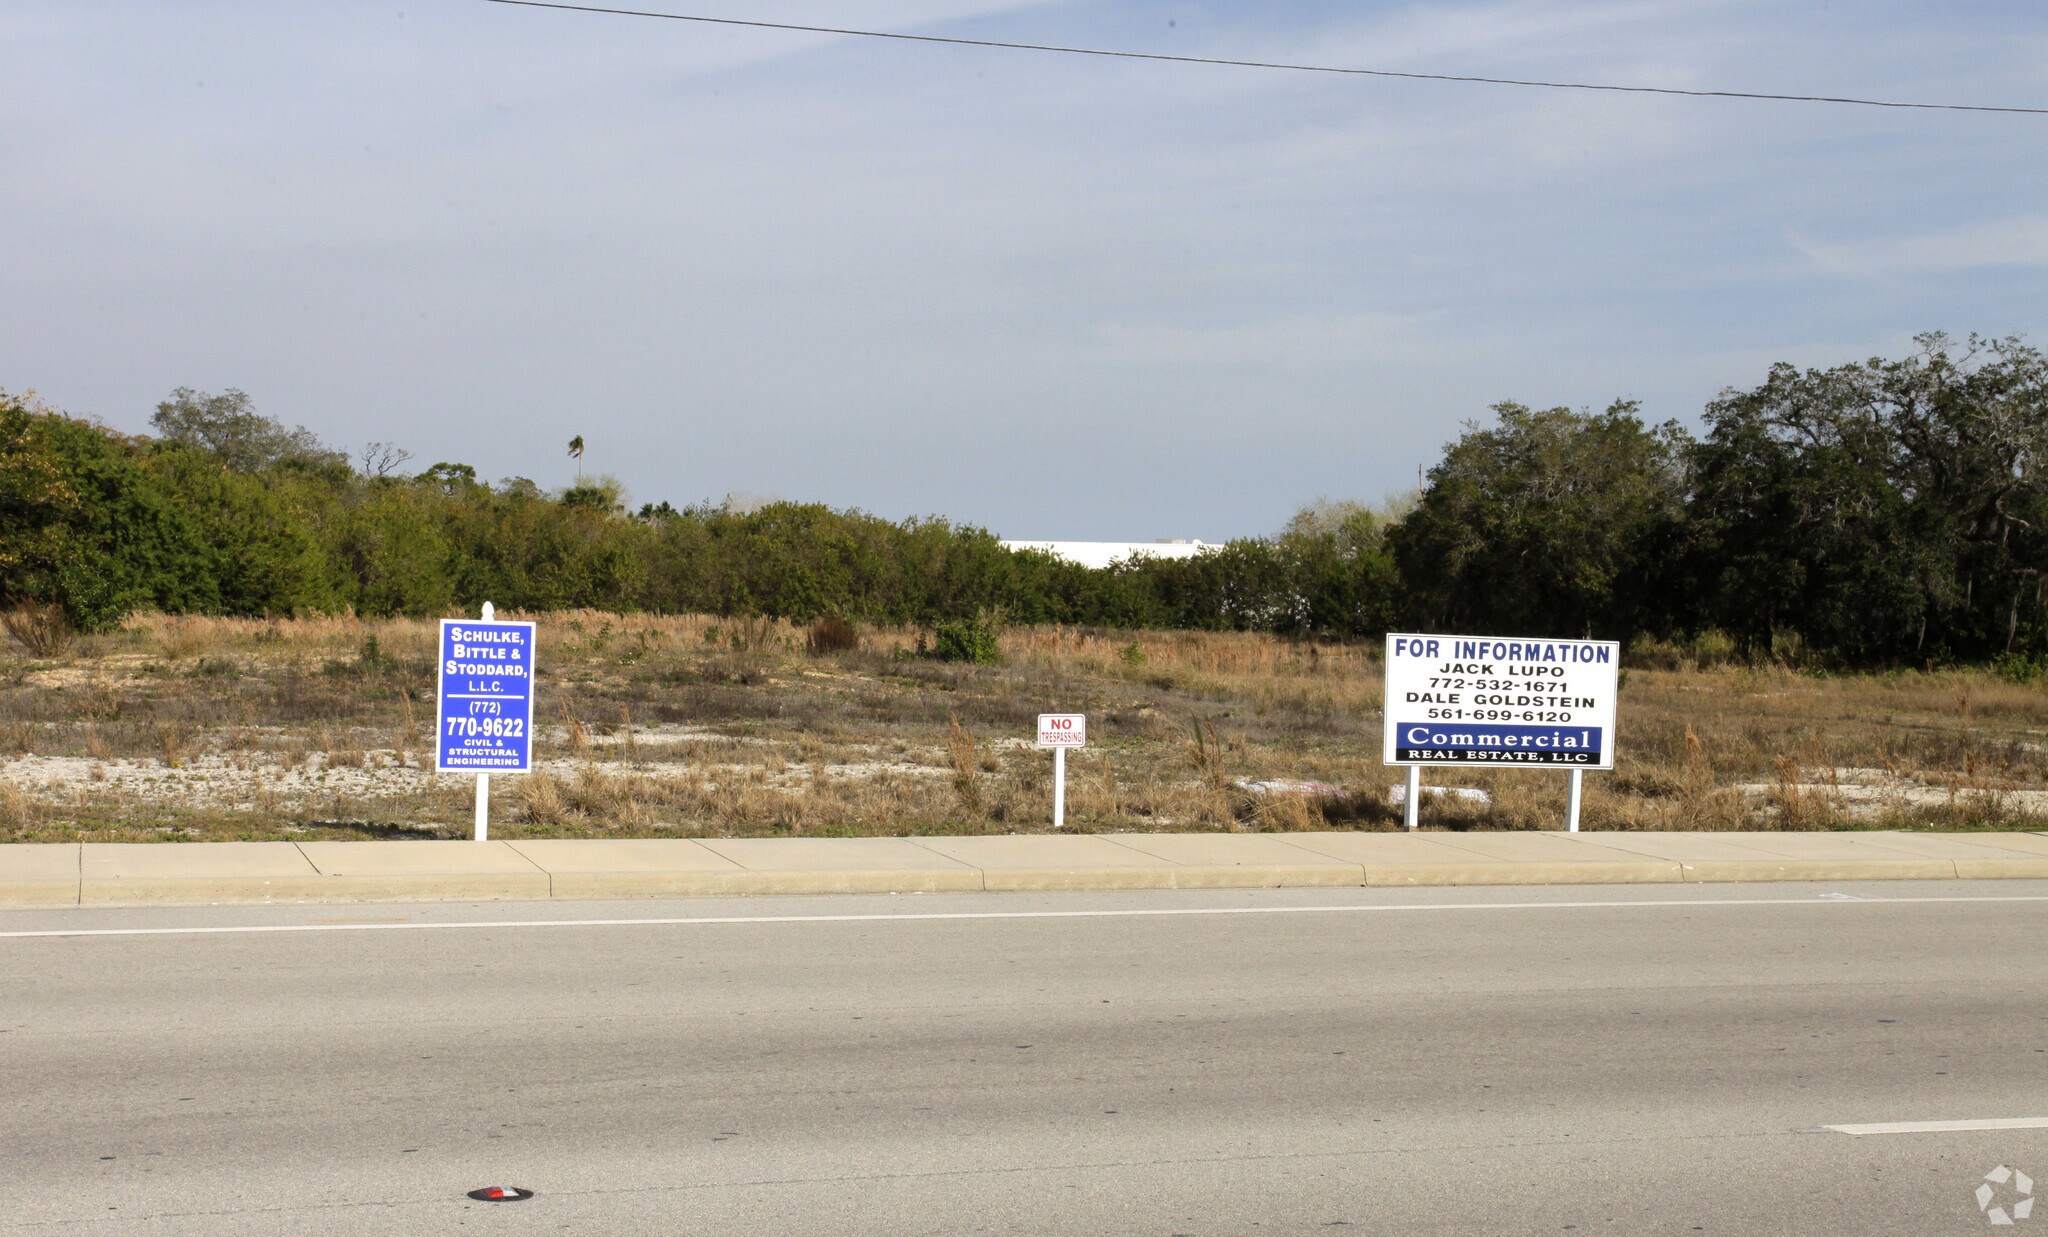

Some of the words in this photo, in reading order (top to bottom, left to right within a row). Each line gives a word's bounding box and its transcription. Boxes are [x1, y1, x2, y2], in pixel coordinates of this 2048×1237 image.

[451, 627, 524, 645] SCHULKE,
[454, 644, 506, 659] BITTLE
[511, 649, 521, 659] &
[1396, 639, 1439, 658] FOR
[1455, 641, 1609, 663] INFORMATION
[446, 661, 527, 678] STODDARD,
[1440, 663, 1494, 674] JACK
[1509, 666, 1564, 676] LUPO
[469, 681, 504, 692] L.L.C.
[1429, 678, 1567, 692] 772-532-1671
[1406, 693, 1460, 704] DALE
[1474, 695, 1595, 708] GOLDSTEIN
[469, 702, 501, 715] (772)
[1428, 709, 1571, 722] 561-699-6120
[447, 717, 523, 737] 770-9622
[1051, 719, 1072, 729] NO
[496, 739, 503, 747] &
[1042, 732, 1081, 742] TRESPASSING
[1407, 728, 1590, 748] Commercial
[449, 748, 518, 756] STRUCTURAL
[1409, 750, 1458, 759] REAL
[1467, 751, 1544, 762] ESTATE,
[1552, 753, 1588, 762] LLC
[447, 758, 520, 766] ENGINEERING
